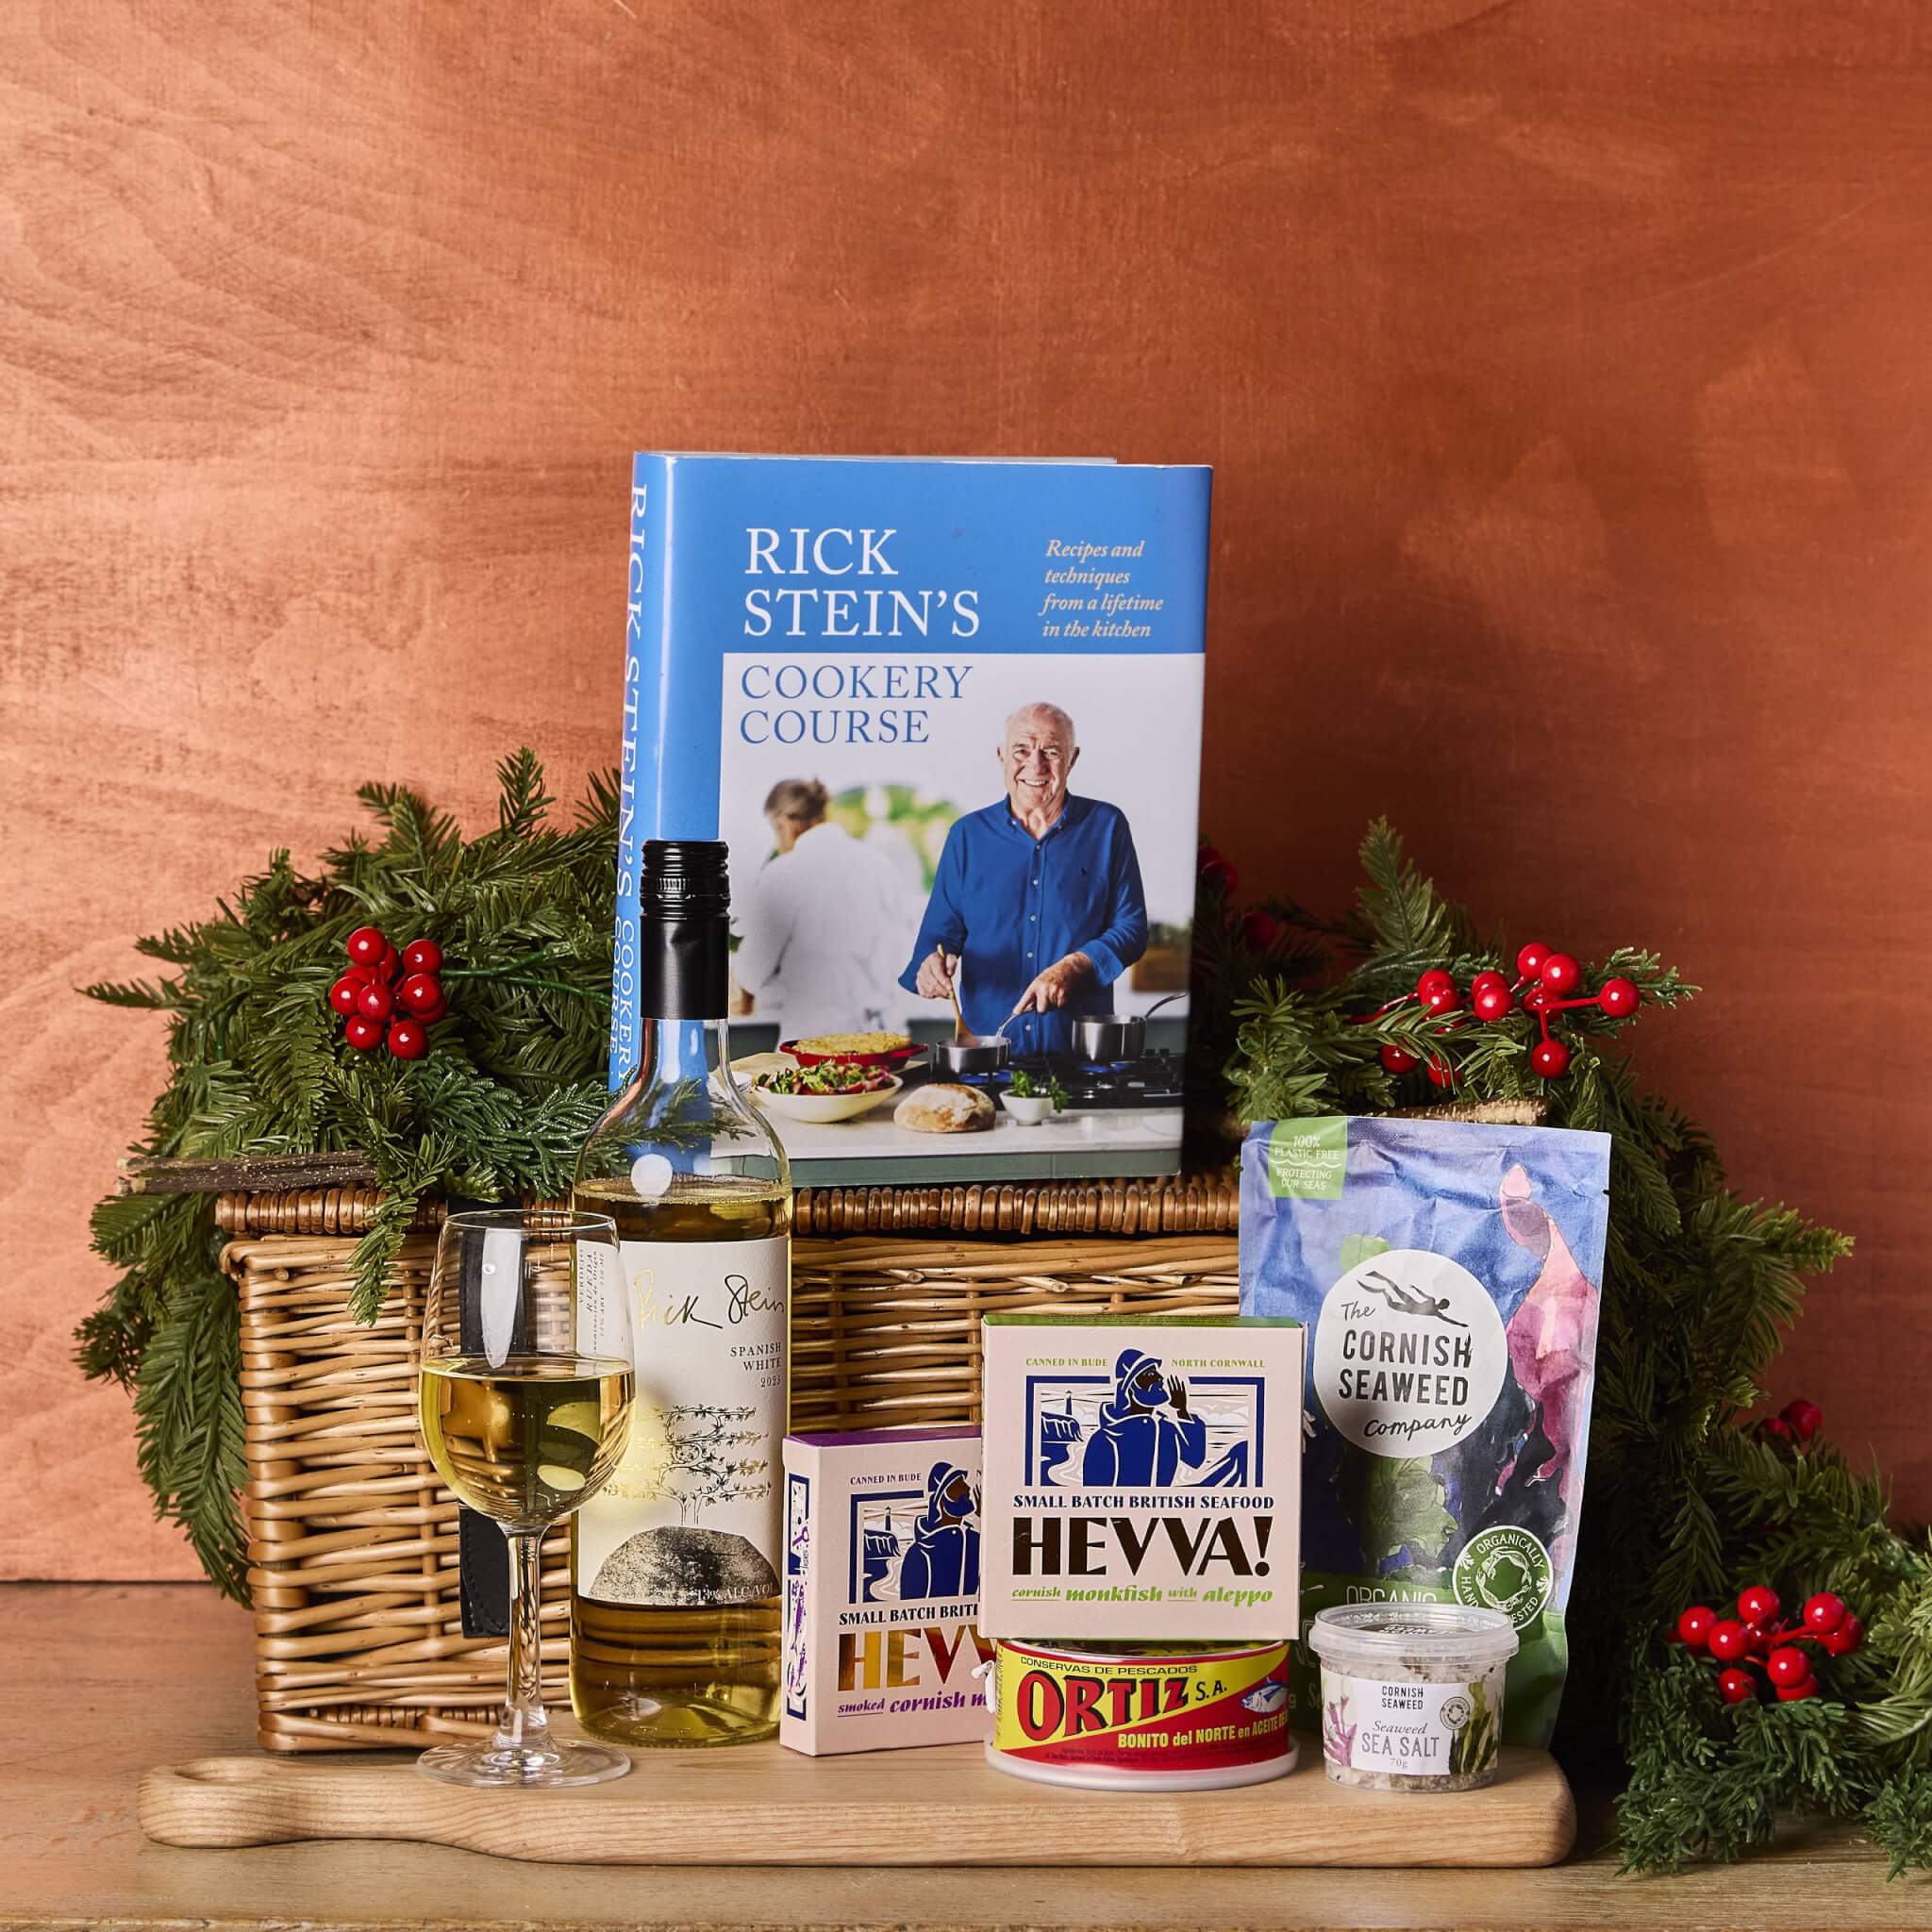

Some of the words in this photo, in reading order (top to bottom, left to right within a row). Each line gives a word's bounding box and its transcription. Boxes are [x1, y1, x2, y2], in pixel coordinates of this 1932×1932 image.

[626, 484, 646, 639] RICK
[744, 526, 899, 575] RICK
[1045, 539, 1108, 564] Recipes
[1110, 539, 1146, 558] and
[1044, 566, 1131, 591] techniques
[743, 588, 980, 638] STEIN'S
[1038, 592, 1084, 617] from
[1087, 598, 1098, 610] a
[1100, 592, 1163, 617] lifetime
[1042, 620, 1060, 637] in
[1063, 619, 1090, 637] the
[1091, 619, 1151, 637] kitchen
[741, 664, 974, 700] COOKERY
[740, 709, 930, 745] COURSE
[1293, 1134, 1321, 1148] 100%
[1274, 1147, 1312, 1158] PLASTIC
[1316, 1149, 1341, 1159] FREE
[1276, 1167, 1332, 1179] PROTECTING
[1304, 1180, 1327, 1191] SEAS
[724, 1274, 785, 1324] Stein
[1341, 1301, 1375, 1321] The
[730, 1342, 781, 1357] SPANISH
[1342, 1328, 1473, 1368] CORNISH
[742, 1357, 781, 1371] WHITE
[1025, 1357, 1065, 1367] CANNED
[1068, 1357, 1079, 1367] IN
[1081, 1357, 1108, 1367] BUDE
[1172, 1358, 1208, 1368] NORTH
[1209, 1358, 1266, 1368] CORNWALL
[1338, 1368, 1469, 1406] SEAWEED
[1363, 1414, 1473, 1441] Company
[850, 1474, 884, 1485] CANNED
[887, 1474, 896, 1483] IN
[898, 1473, 922, 1482] BUDE
[1013, 1494, 1067, 1508] SMALL
[1072, 1494, 1124, 1508] BATCH
[1129, 1494, 1195, 1508] BRITISH
[1200, 1495, 1274, 1509] SEAFOOD
[1012, 1516, 1274, 1576] HEVVA!
[1476, 1533, 1545, 1568] ORGANICALLY
[1012, 1587, 1061, 1599] cornish
[1066, 1585, 1163, 1602] monkfish
[1168, 1587, 1197, 1598] with
[1203, 1587, 1274, 1607] aleppo
[839, 1611, 887, 1625] SMALL
[890, 1607, 935, 1622] BATCH
[940, 1603, 978, 1618] BRITI
[1511, 1596, 1539, 1624] ESTED
[1020, 1656, 1091, 1674] CONSERVAS
[1094, 1666, 1113, 1675] DE
[1118, 1665, 1198, 1675] PESCADOS
[838, 1698, 885, 1713] smoked
[890, 1690, 966, 1713] cornish
[1382, 1685, 1424, 1698] CORNISH
[1017, 1669, 1190, 1741] ORTIZ
[1382, 1698, 1424, 1710] SEAWEED
[1118, 1733, 1169, 1749] BONITO
[1173, 1731, 1192, 1747] del
[1195, 1724, 1236, 1744] NORTE
[1238, 1726, 1250, 1738] en
[1252, 1715, 1278, 1736] ACEITE
[1373, 1720, 1428, 1735] Seaweed
[1361, 1732, 1392, 1756] SEA
[1399, 1736, 1440, 1757] SALT
[1390, 1757, 1409, 1770] 70g
